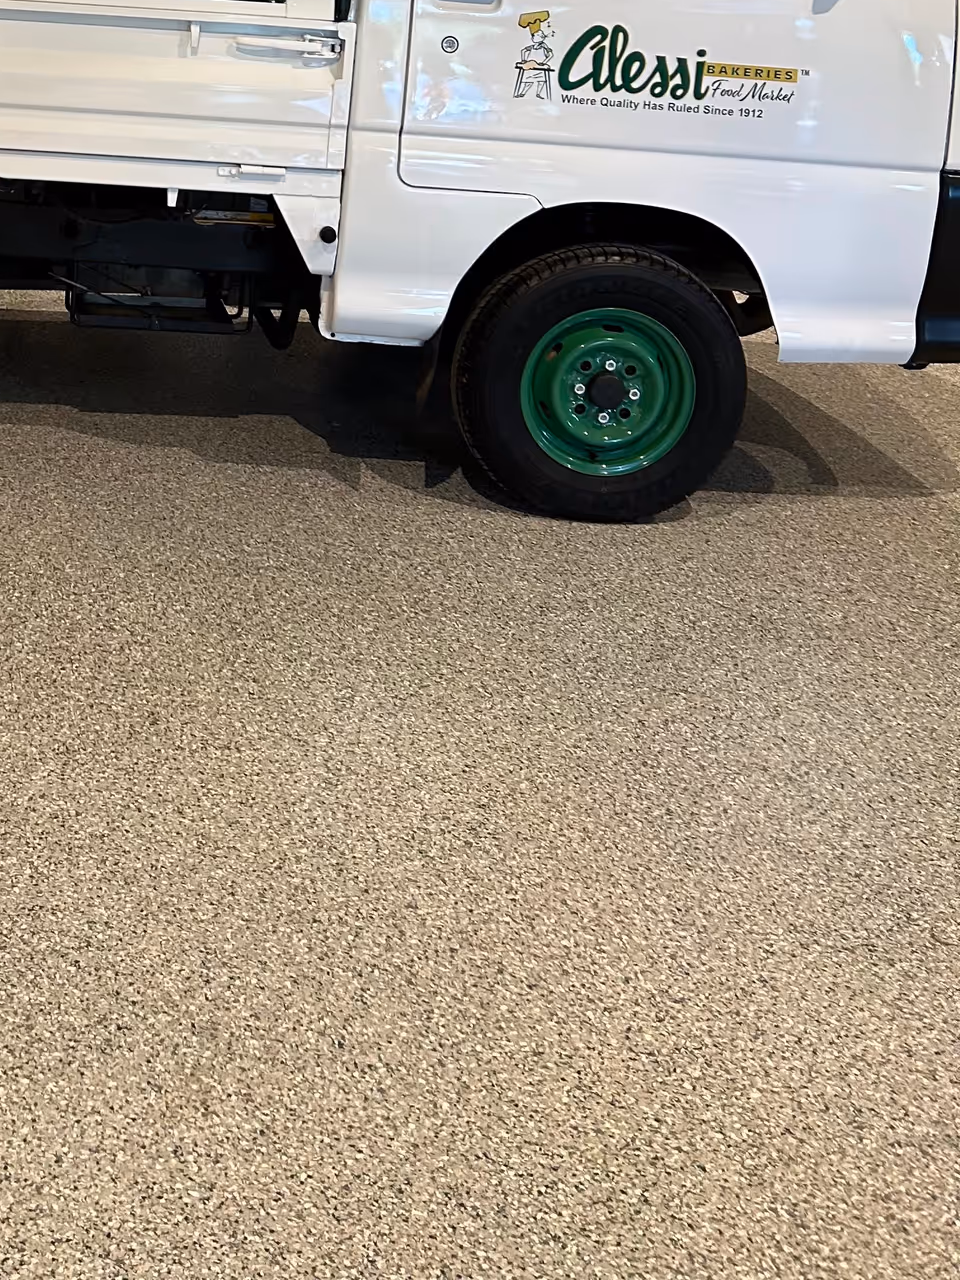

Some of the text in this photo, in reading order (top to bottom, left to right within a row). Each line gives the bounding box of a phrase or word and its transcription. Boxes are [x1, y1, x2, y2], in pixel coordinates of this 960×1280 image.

[558, 24, 709, 101] Alessi
[706, 65, 793, 80] BAKERIES
[711, 79, 796, 104] Food Market
[561, 94, 764, 118] Where Quality Has Ruled Since 1912
